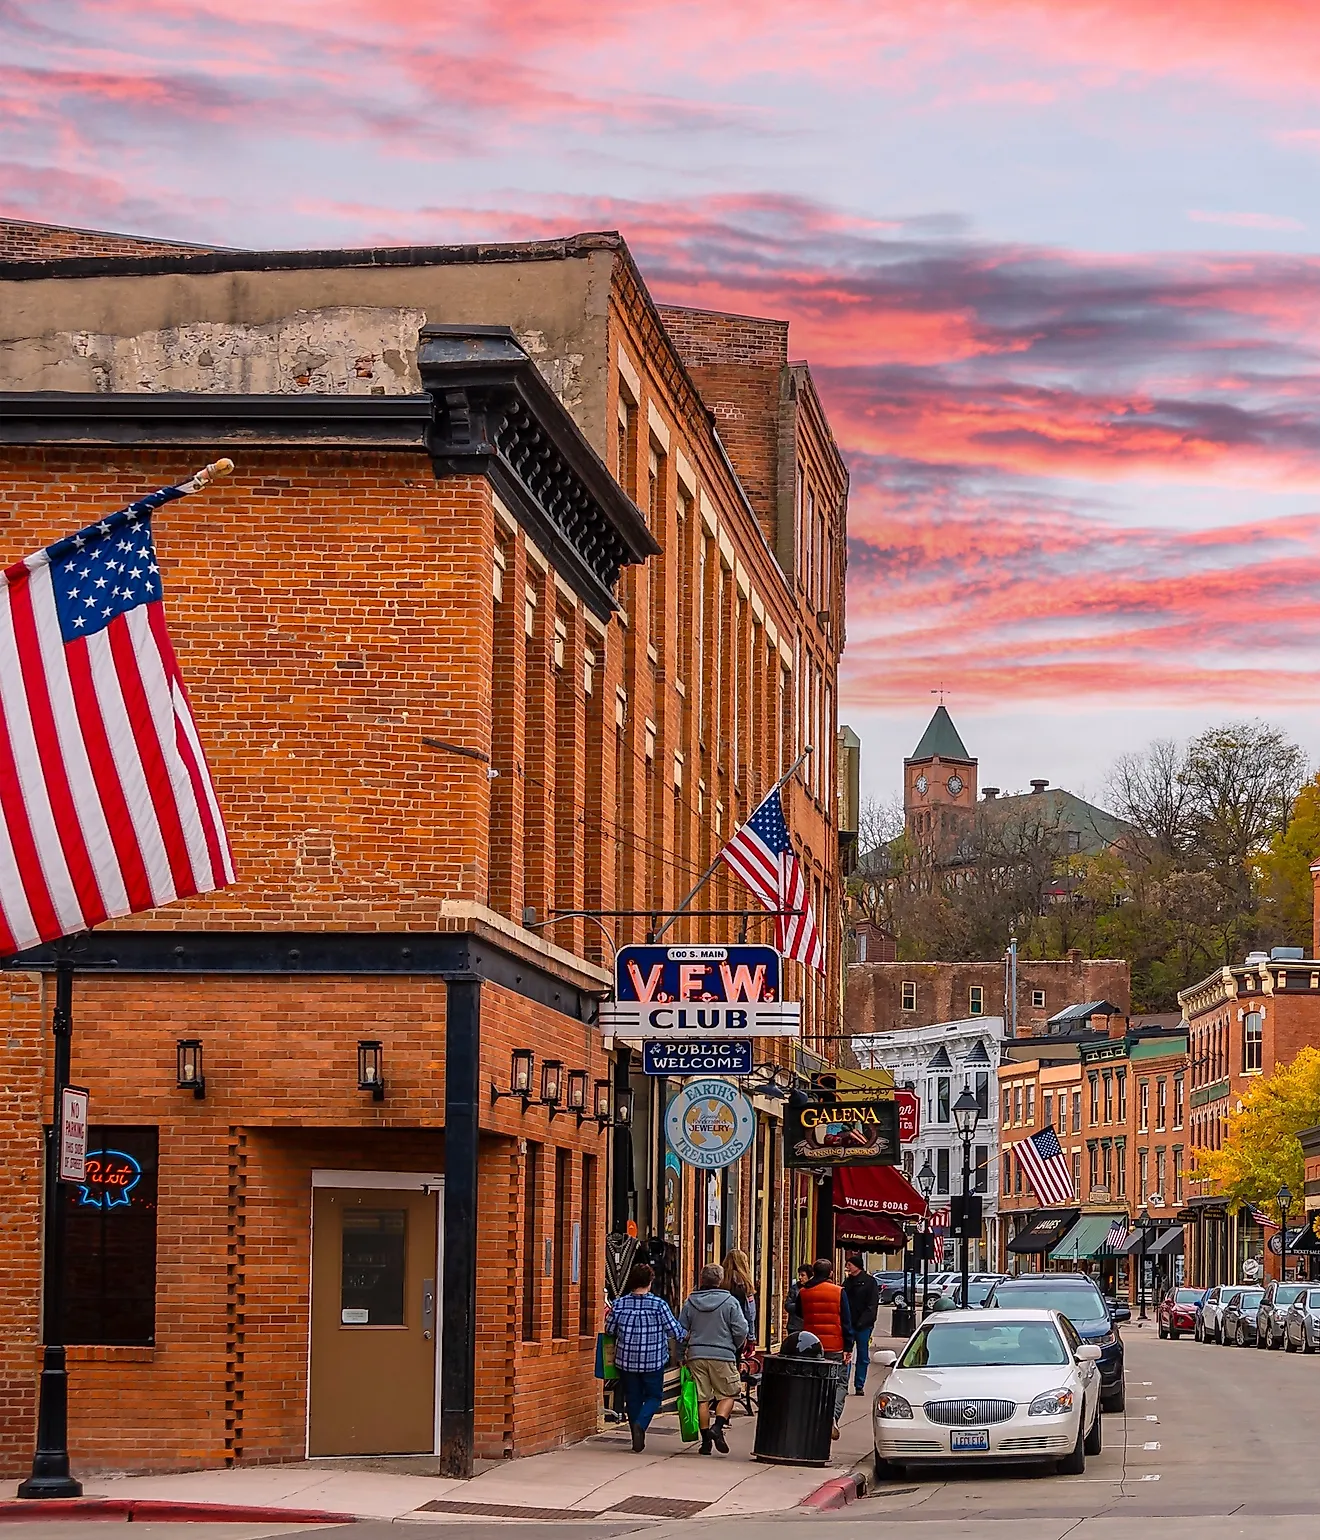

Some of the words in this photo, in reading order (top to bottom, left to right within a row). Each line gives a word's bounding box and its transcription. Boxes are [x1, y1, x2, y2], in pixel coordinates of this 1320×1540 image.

[671, 950, 687, 958] 100
[689, 950, 698, 958] S.
[700, 950, 724, 958] MAIN
[648, 1009, 748, 1029] CLUB
[664, 1044, 731, 1056] PUBLIC
[652, 1057, 743, 1069] WELCOME
[684, 1084, 737, 1102] EARTH'S
[70, 1101, 80, 1119] NO
[800, 1106, 881, 1128] GALENA
[65, 1120, 84, 1139] PARKING
[688, 1124, 730, 1132] JEWELRY
[65, 1141, 74, 1154] THIS
[75, 1143, 84, 1156] SIDE
[674, 1136, 744, 1165] TREASURES
[807, 1148, 842, 1157] CANNING
[844, 1147, 878, 1156] COMPANY
[64, 1156, 70, 1168] OF
[70, 1157, 83, 1170] STREET
[845, 1197, 879, 1208] VINTAGE
[882, 1201, 908, 1211] SODAS
